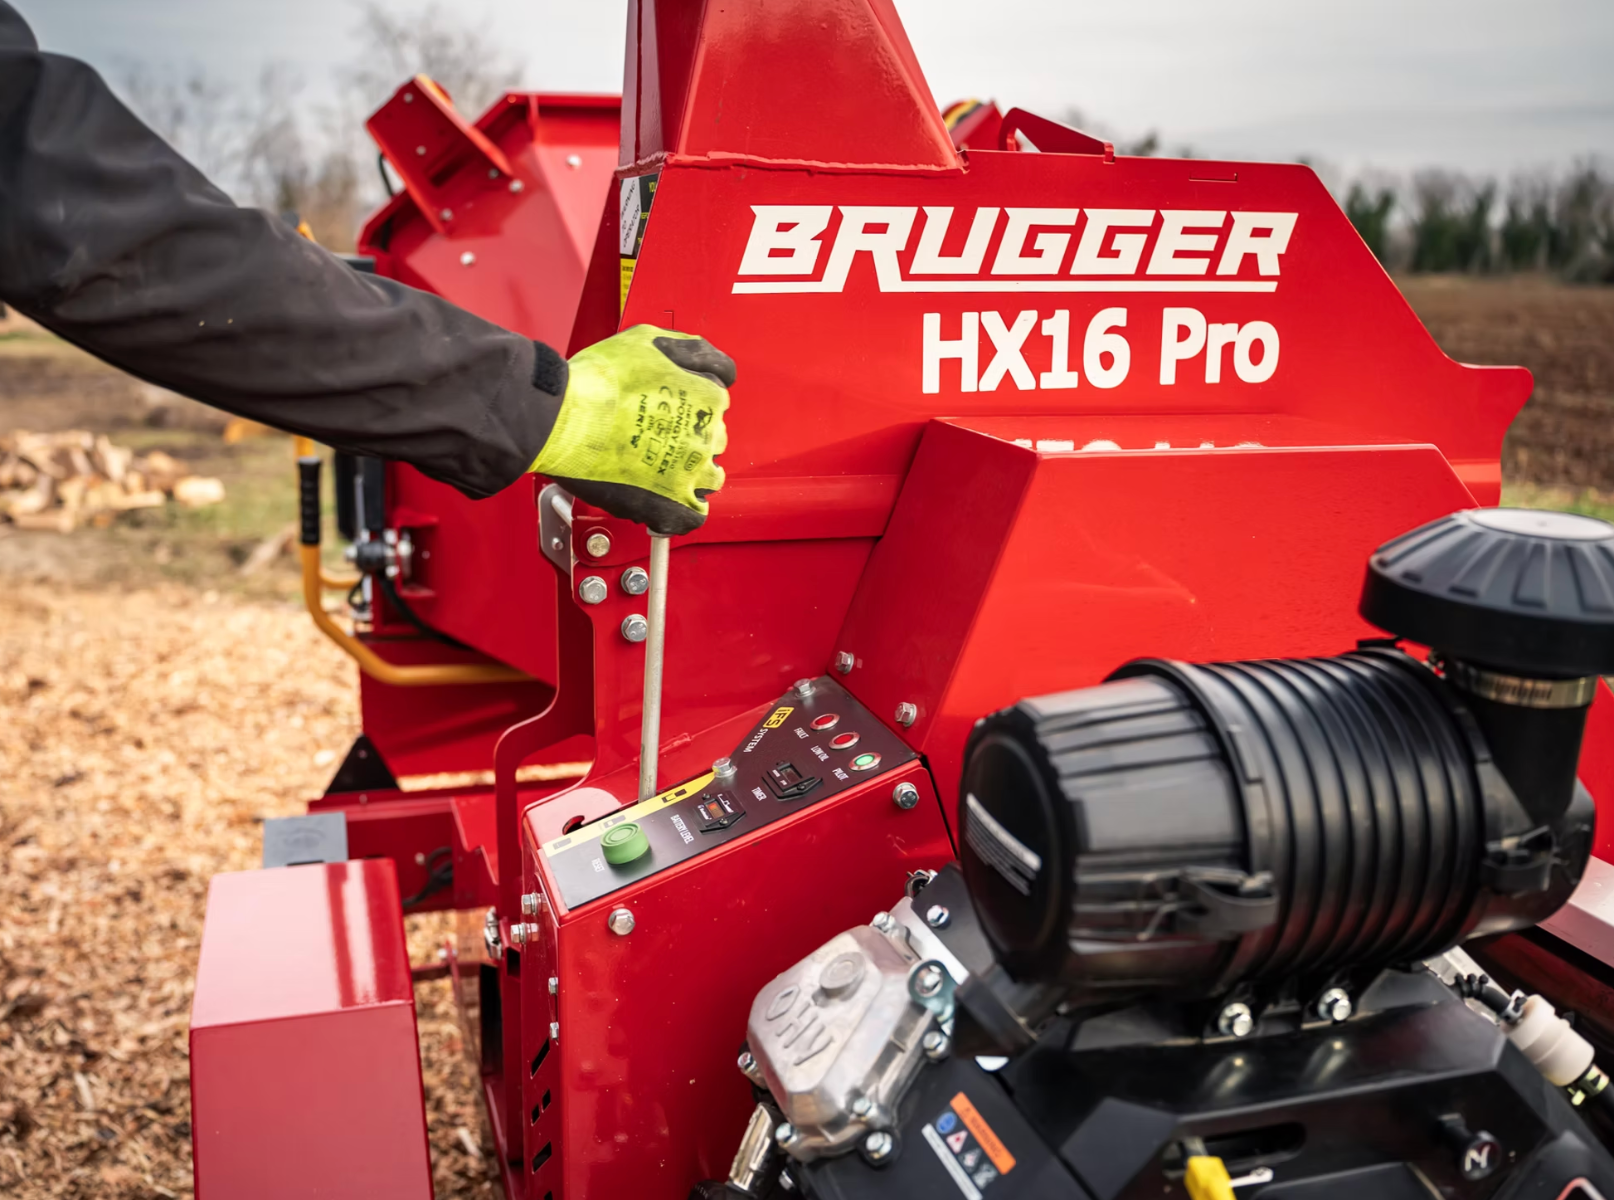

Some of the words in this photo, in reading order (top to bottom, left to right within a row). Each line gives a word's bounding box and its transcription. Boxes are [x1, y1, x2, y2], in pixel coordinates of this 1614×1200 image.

[731, 205, 1298, 295] BRUGGER
[922, 307, 1130, 394] HX16
[1159, 307, 1280, 386] Pro
[672, 389, 688, 443] SPONGY
[657, 444, 676, 475] FLEX
[743, 728, 768, 753] SYSTEM
[794, 727, 809, 739] FAULT
[810, 745, 823, 758] LOW
[819, 753, 830, 762] OIL
[832, 767, 849, 782] PILOT
[751, 786, 768, 801] TIMER
[670, 814, 688, 834] BATTERY
[680, 829, 695, 844] LEVEL
